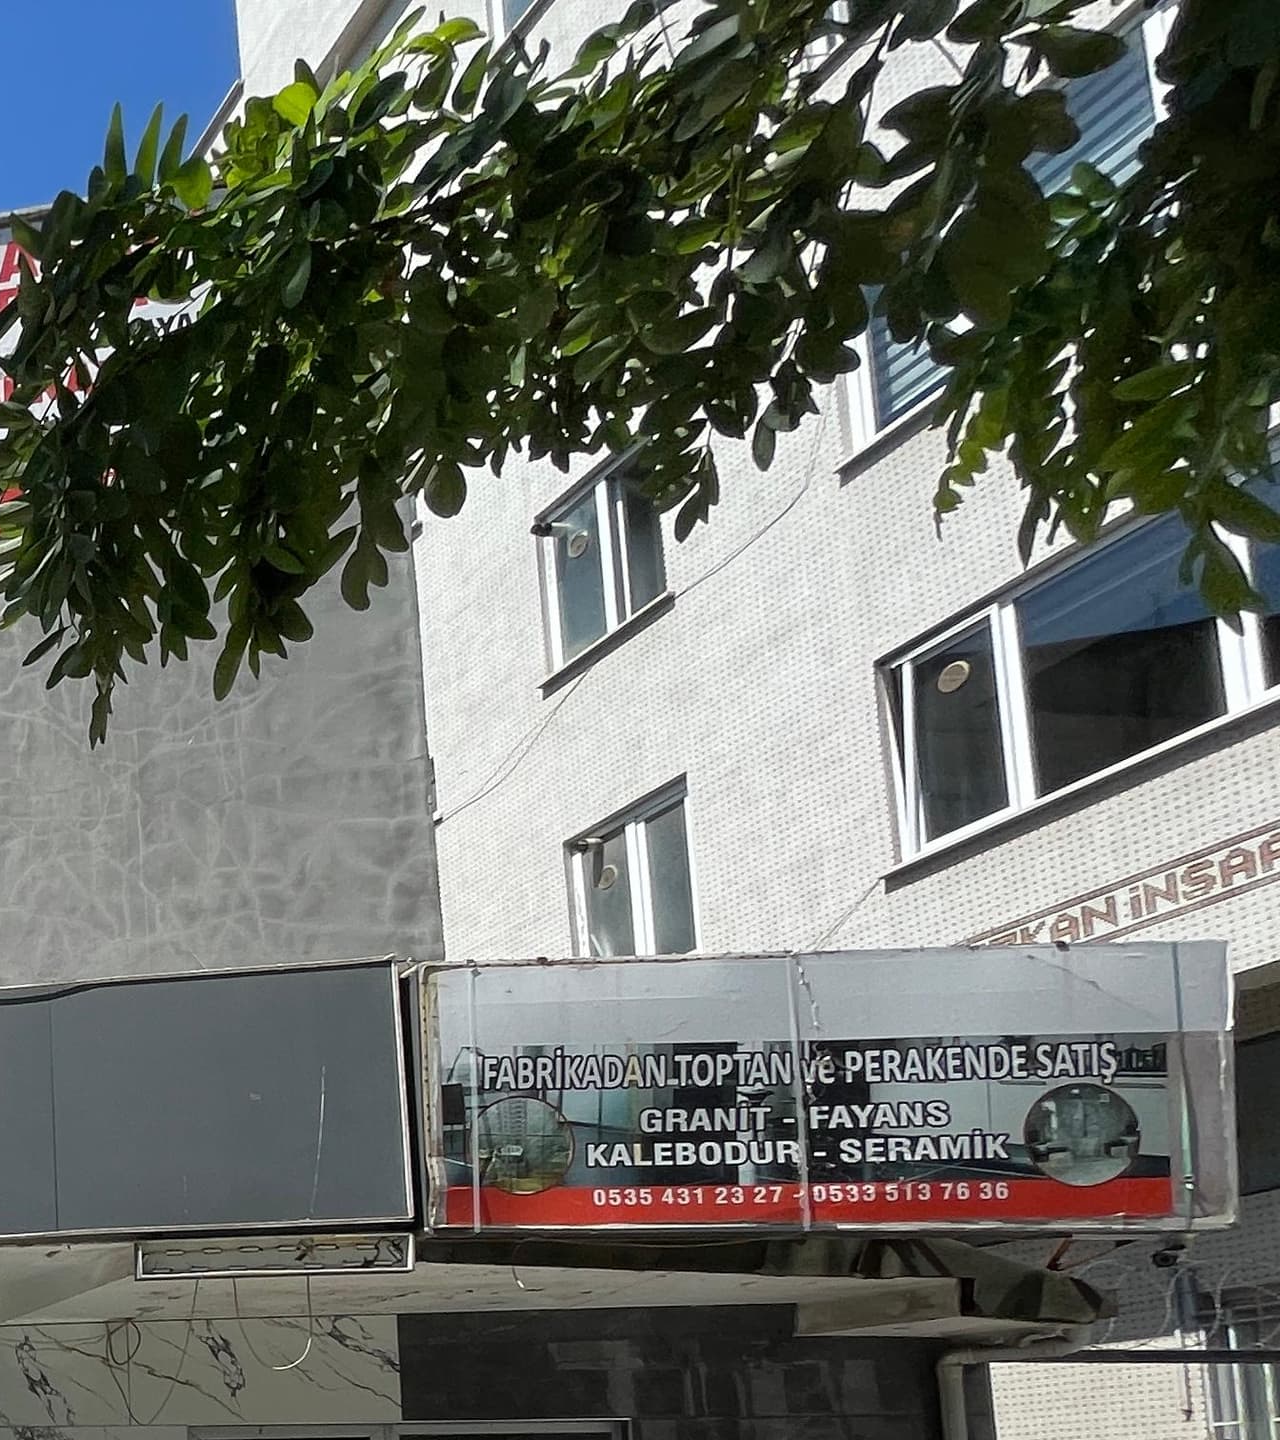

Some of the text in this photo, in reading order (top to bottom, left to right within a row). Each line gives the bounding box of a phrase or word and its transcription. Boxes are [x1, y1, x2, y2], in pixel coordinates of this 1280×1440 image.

[483, 1048, 667, 1090] FABRİKADAN
[674, 1051, 792, 1087] TOPTAN
[845, 1045, 1028, 1083] PERAKENDE
[1037, 1041, 1118, 1084] SATIŞ
[639, 1102, 772, 1134] GRANİT
[809, 1101, 951, 1130] FAYANS
[586, 1140, 802, 1168] KALEBODUR
[839, 1131, 1010, 1164] SERAMİK
[593, 1188, 653, 1206] 0535
[661, 1188, 705, 1205] 431
[715, 1187, 745, 1204] 23
[753, 1186, 784, 1204] 27
[812, 1184, 877, 1203] 0533
[885, 1183, 932, 1202] 513
[940, 1183, 971, 1201] 76
[979, 1182, 1010, 1200] 36
